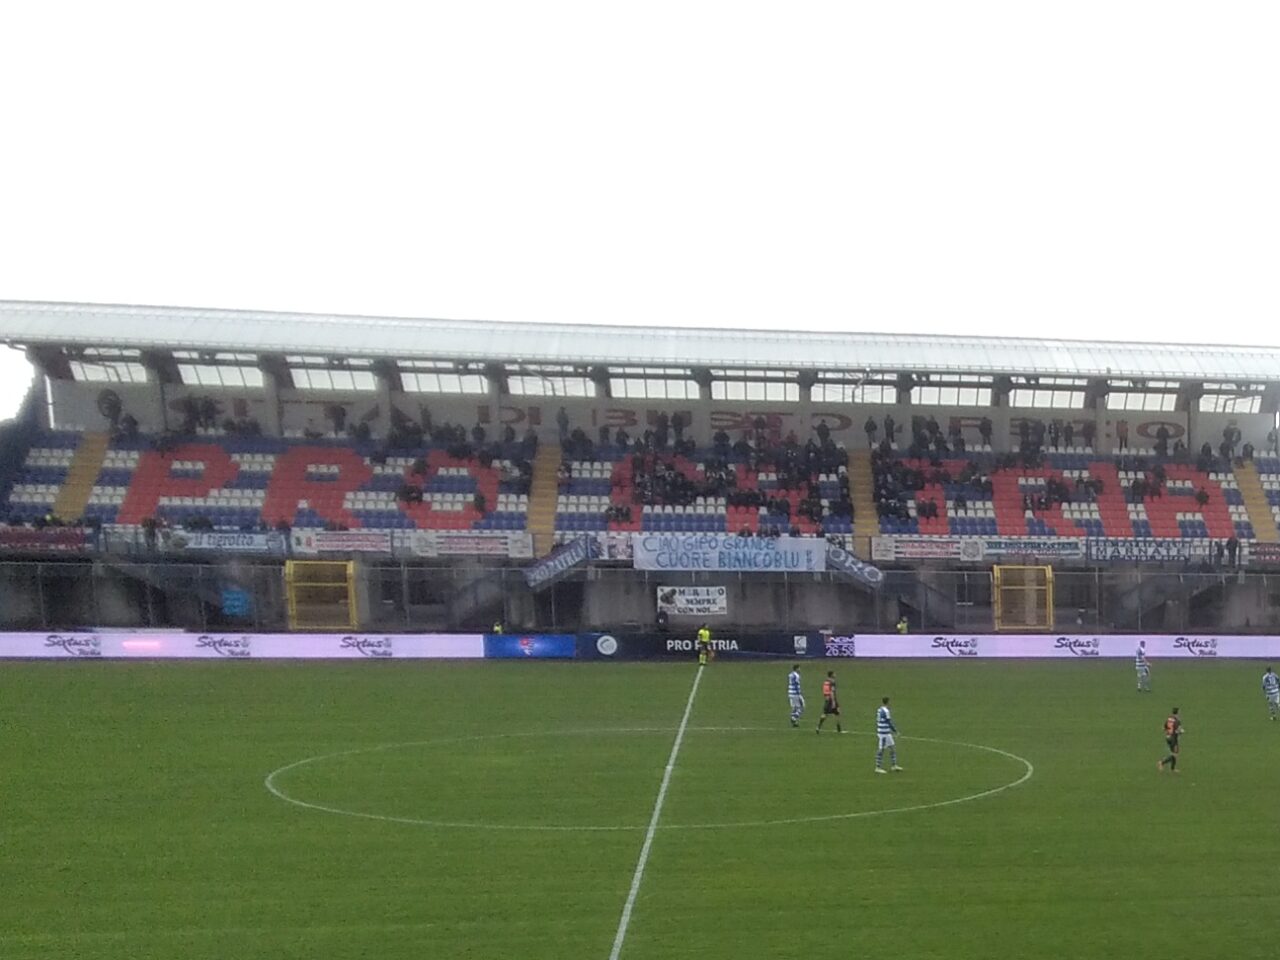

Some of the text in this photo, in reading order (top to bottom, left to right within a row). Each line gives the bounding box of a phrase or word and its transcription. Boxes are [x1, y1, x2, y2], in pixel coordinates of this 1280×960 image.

[643, 537, 776, 552] CIAO GIPO GRANDE
[656, 552, 711, 568] CUORE
[718, 551, 799, 568] BIANCOBLU
[666, 639, 738, 651] PRO PTRIA
